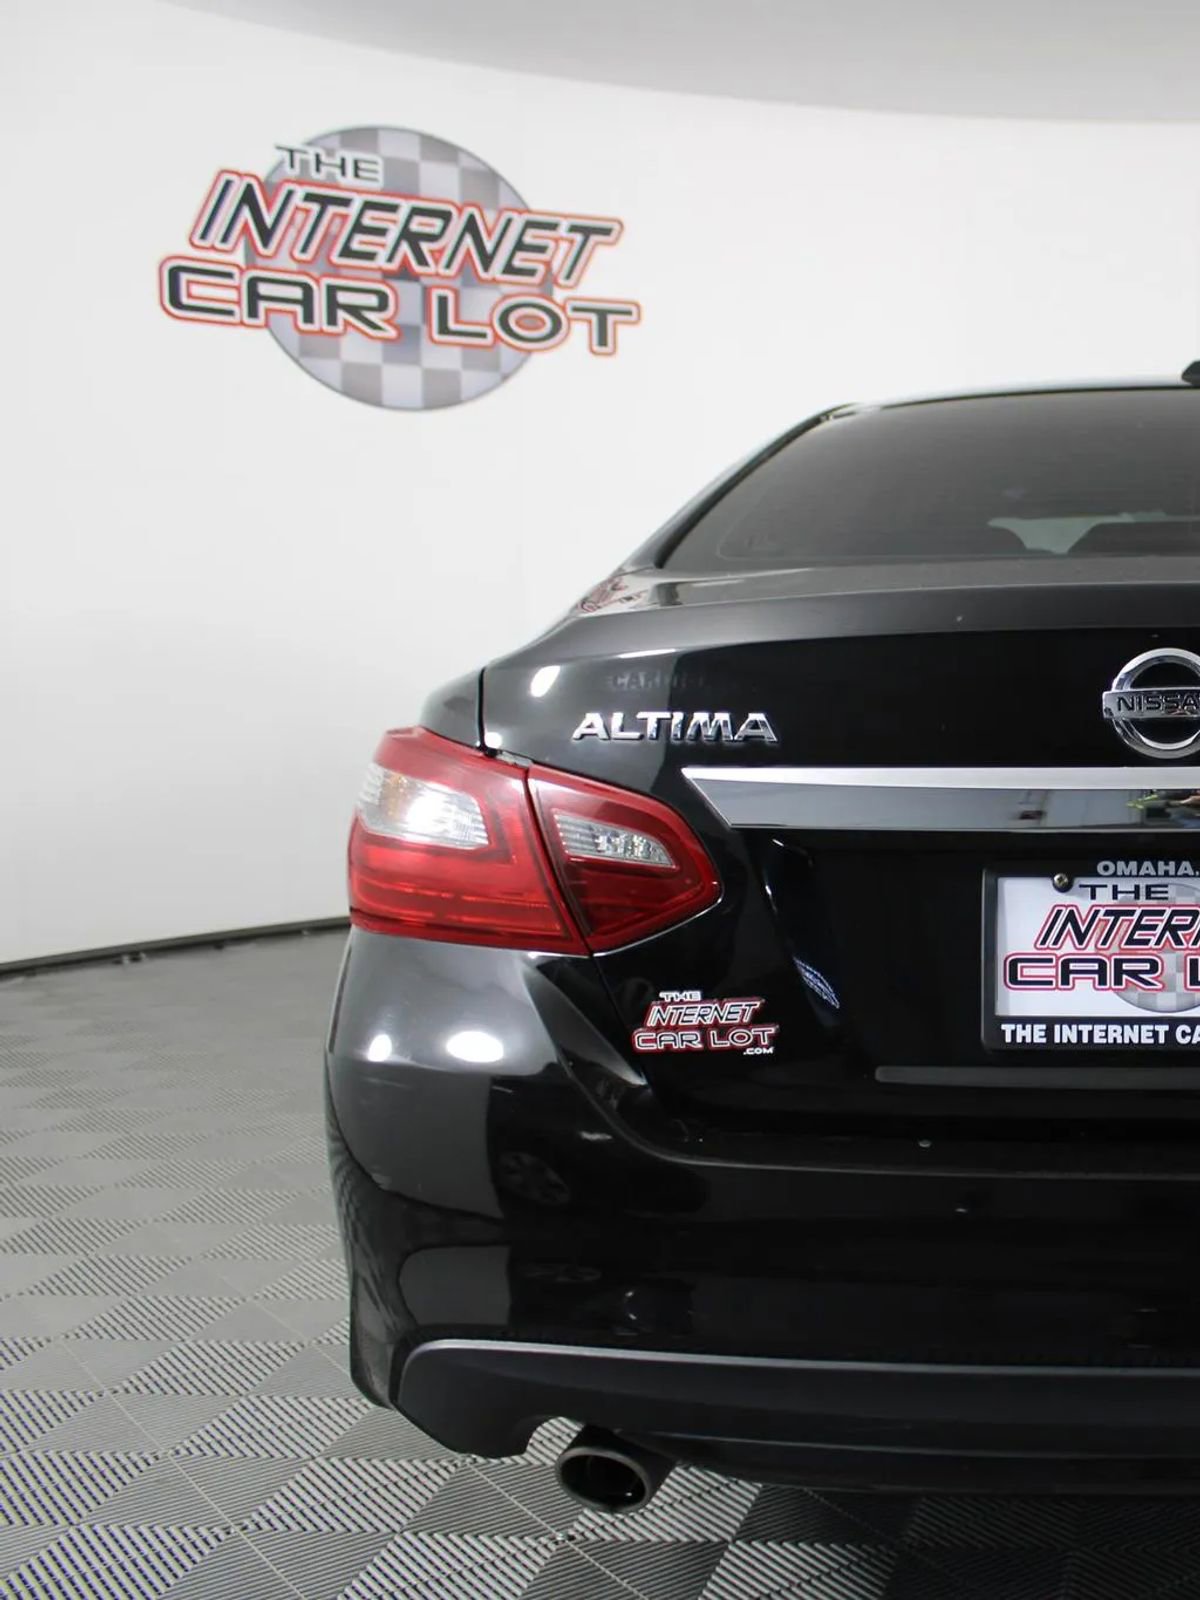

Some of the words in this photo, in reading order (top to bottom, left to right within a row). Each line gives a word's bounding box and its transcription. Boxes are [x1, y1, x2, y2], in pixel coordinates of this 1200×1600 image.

[275, 145, 381, 183] THE
[194, 173, 619, 285] INTERNET
[162, 260, 393, 337] CAR
[431, 290, 637, 351] LOT
[572, 711, 779, 743] ALTIMA
[1079, 884, 1169, 901] THE
[1006, 955, 1164, 989] CAR
[658, 991, 701, 1002] THE
[646, 1001, 762, 1026] INTERNET
[634, 1030, 704, 1049] CAR
[710, 1027, 776, 1048] LOT
[1001, 1024, 1047, 1044] THE
[1054, 1024, 1169, 1044] INTERNET
[743, 1046, 774, 1056] .COM
